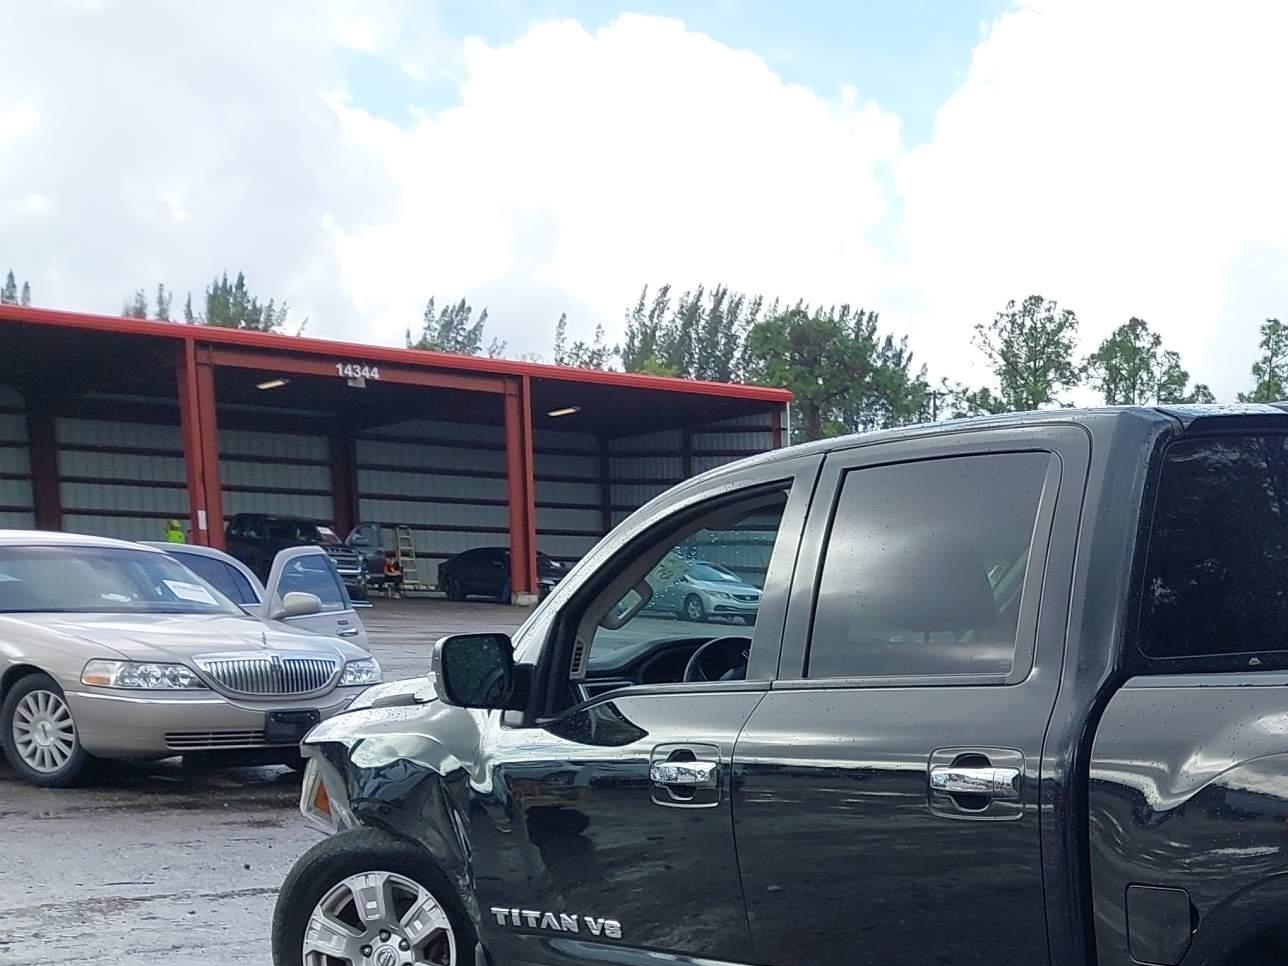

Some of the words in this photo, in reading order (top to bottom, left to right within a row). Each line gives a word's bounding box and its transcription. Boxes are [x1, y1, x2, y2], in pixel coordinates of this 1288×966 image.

[335, 362, 380, 380] 14344
[490, 907, 579, 933] TITAN
[583, 916, 622, 938] V8
